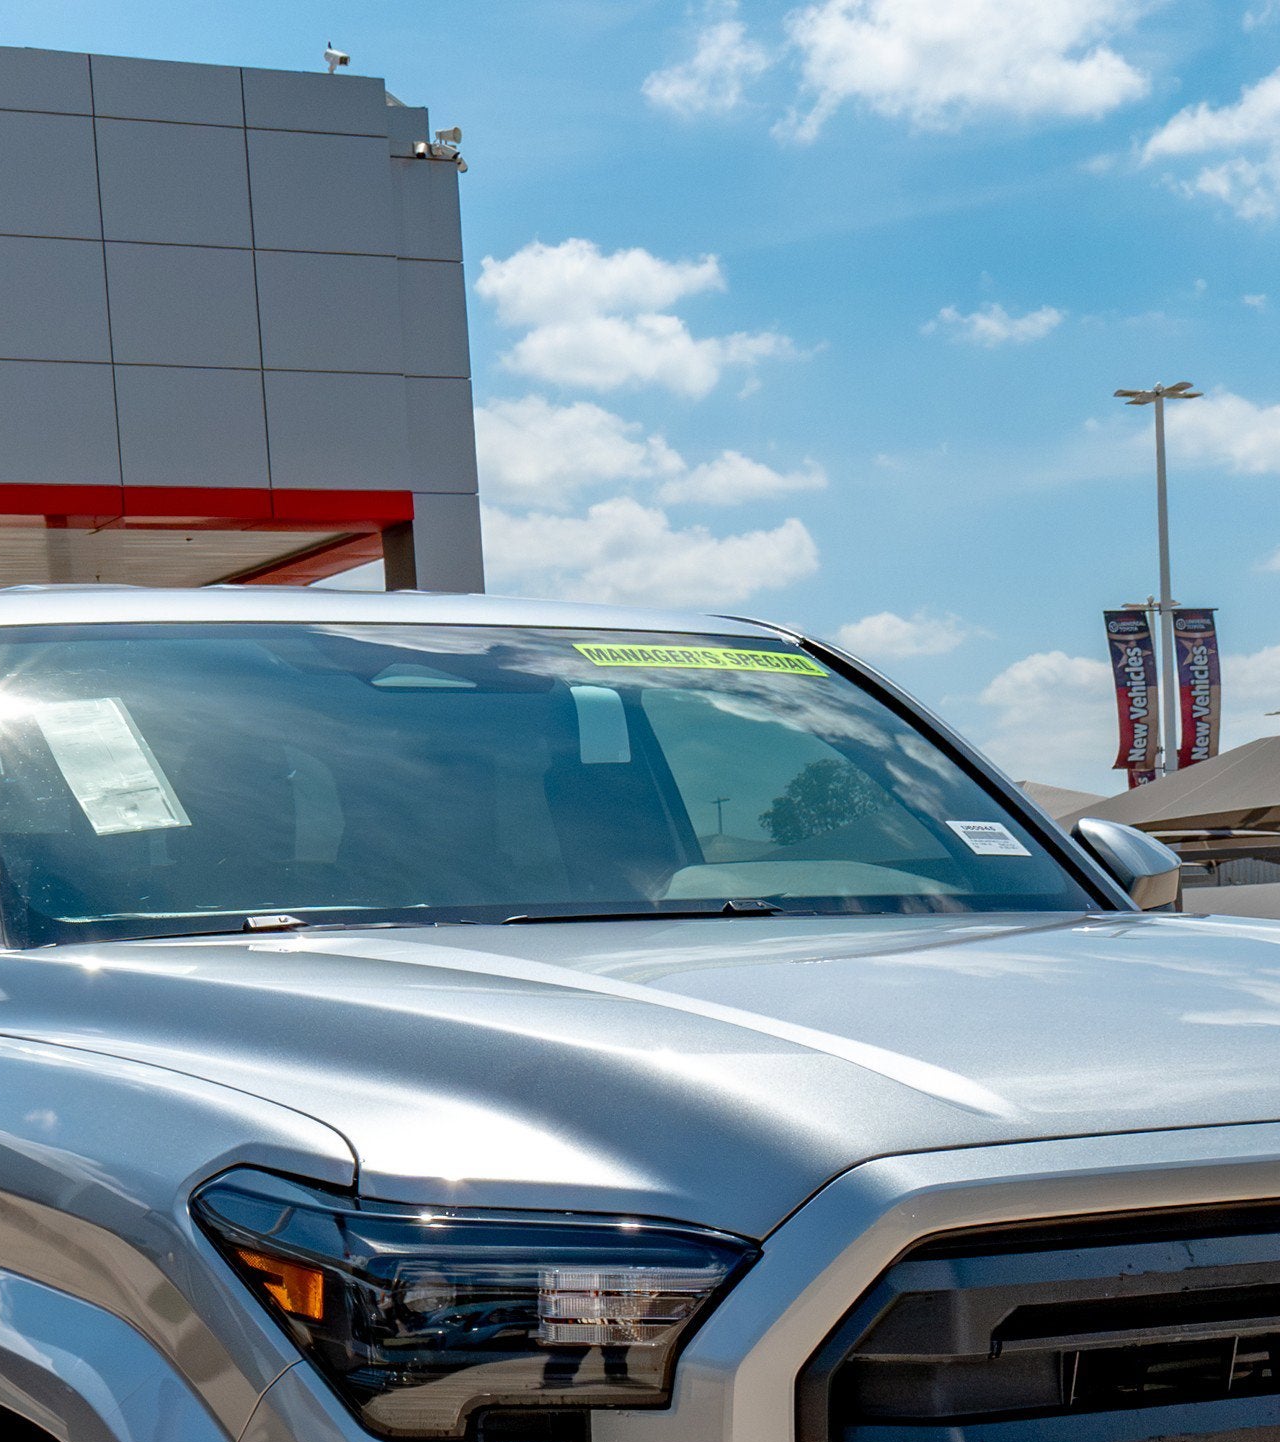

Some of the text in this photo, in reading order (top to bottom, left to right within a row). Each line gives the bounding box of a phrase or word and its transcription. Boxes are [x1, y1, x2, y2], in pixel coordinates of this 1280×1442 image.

[583, 647, 815, 671] MANAGER'S SPECIAL
[1125, 646, 1148, 720] Vehicles
[1191, 644, 1210, 720] Vehicles
[1128, 721, 1148, 762] New
[1191, 720, 1210, 761] New
